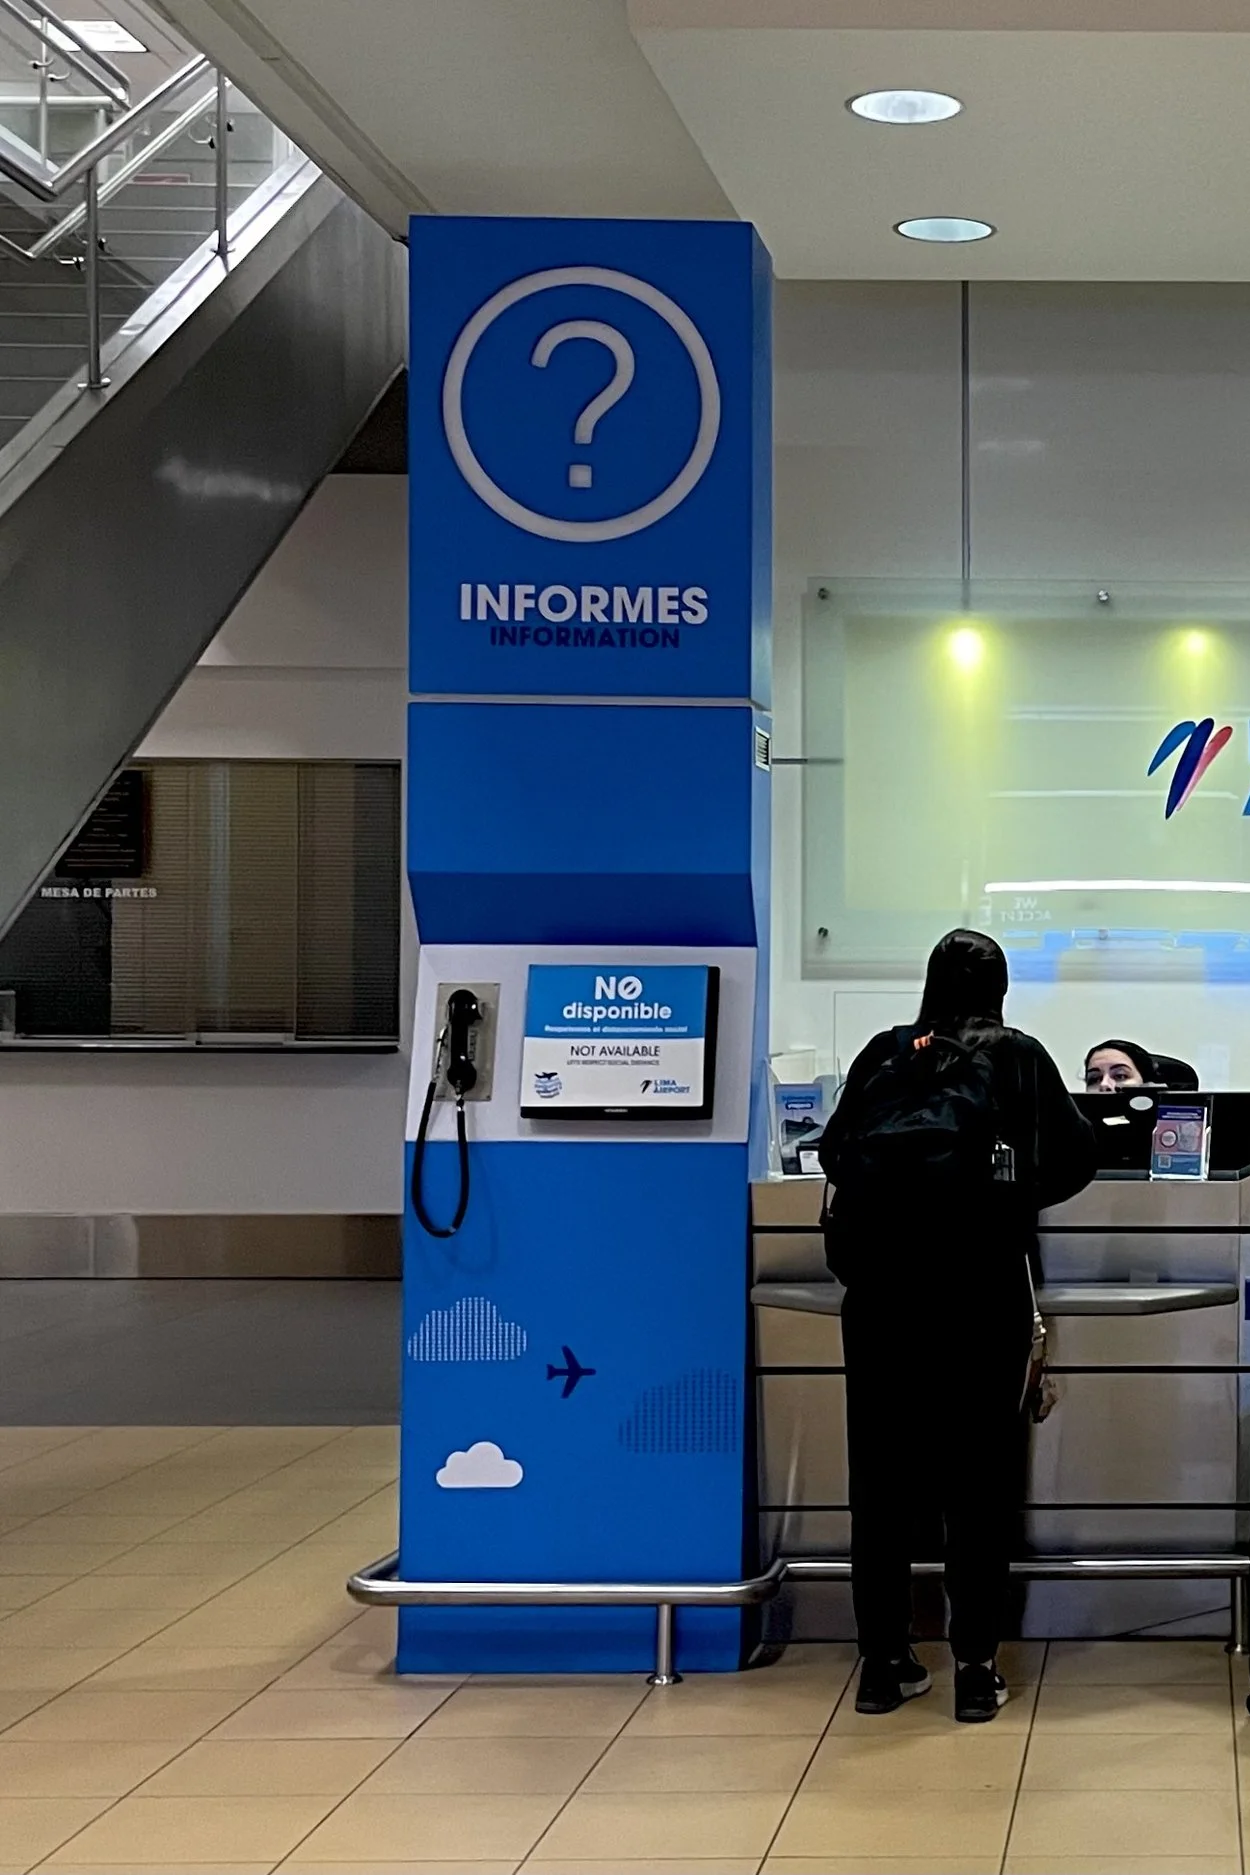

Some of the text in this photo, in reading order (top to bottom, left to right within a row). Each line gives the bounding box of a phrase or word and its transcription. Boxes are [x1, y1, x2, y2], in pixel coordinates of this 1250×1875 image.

[460, 583, 709, 624] INFORMES
[490, 626, 679, 649] INFORMATION
[41, 887, 158, 898] MESA DE PARTES
[594, 976, 643, 1000] NO
[562, 1002, 672, 1022] disponible
[570, 1045, 660, 1057] NOT AVAILABLE
